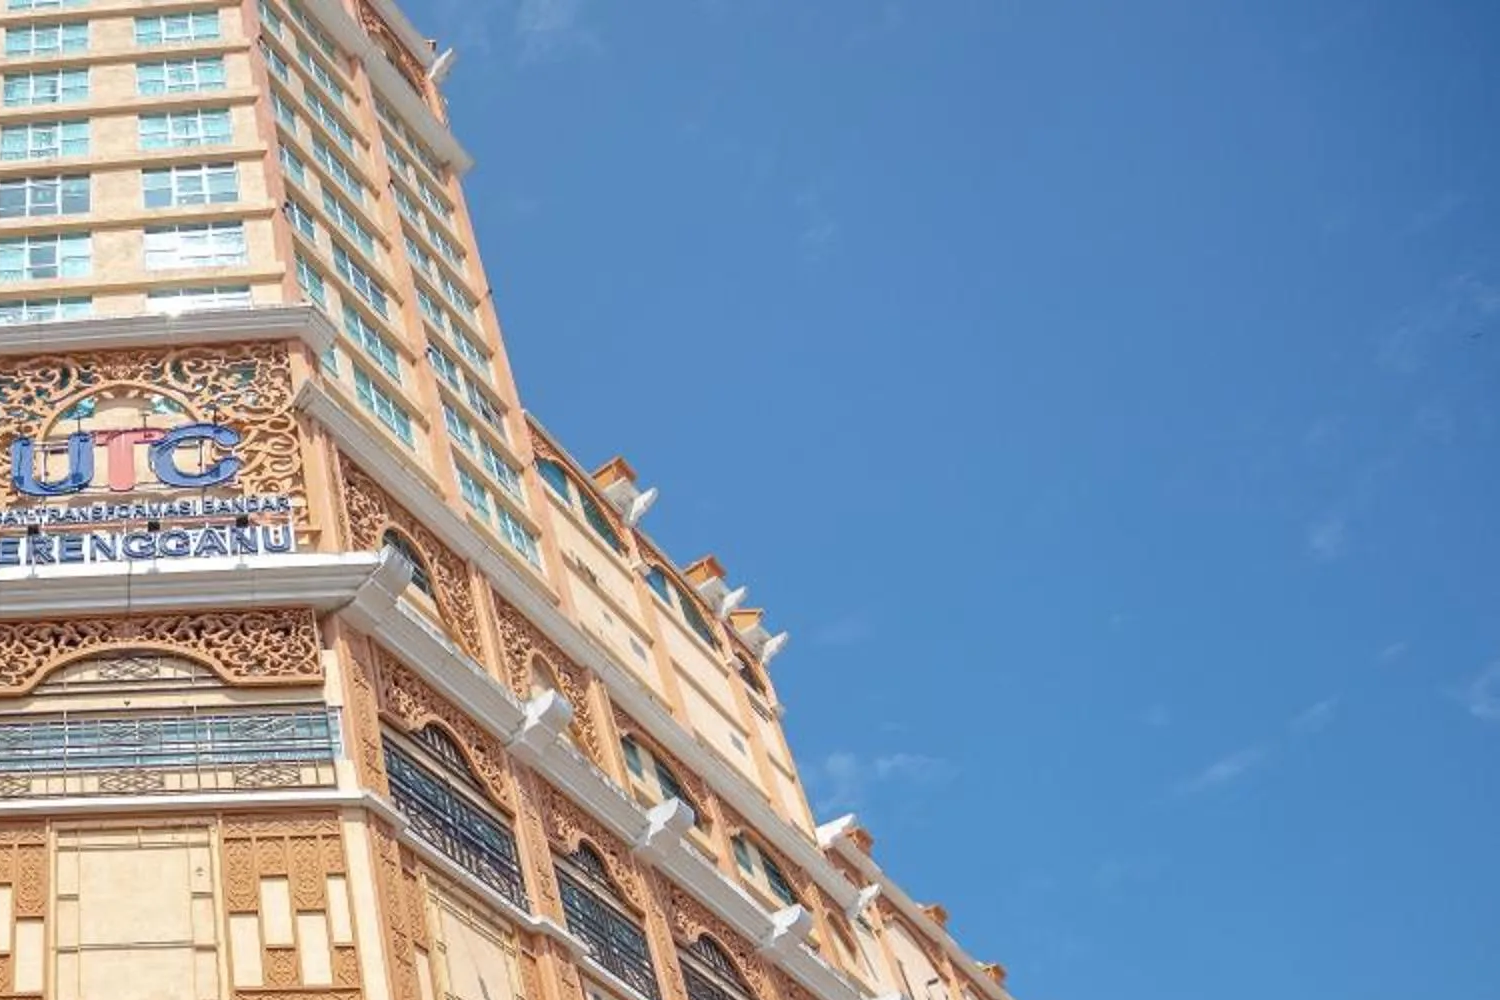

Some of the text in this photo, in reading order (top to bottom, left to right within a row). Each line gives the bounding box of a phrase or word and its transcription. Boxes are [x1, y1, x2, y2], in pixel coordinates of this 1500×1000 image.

[10, 422, 240, 496] UTC
[39, 501, 197, 524] TRANSFORMASI
[203, 496, 292, 515] BANDAR
